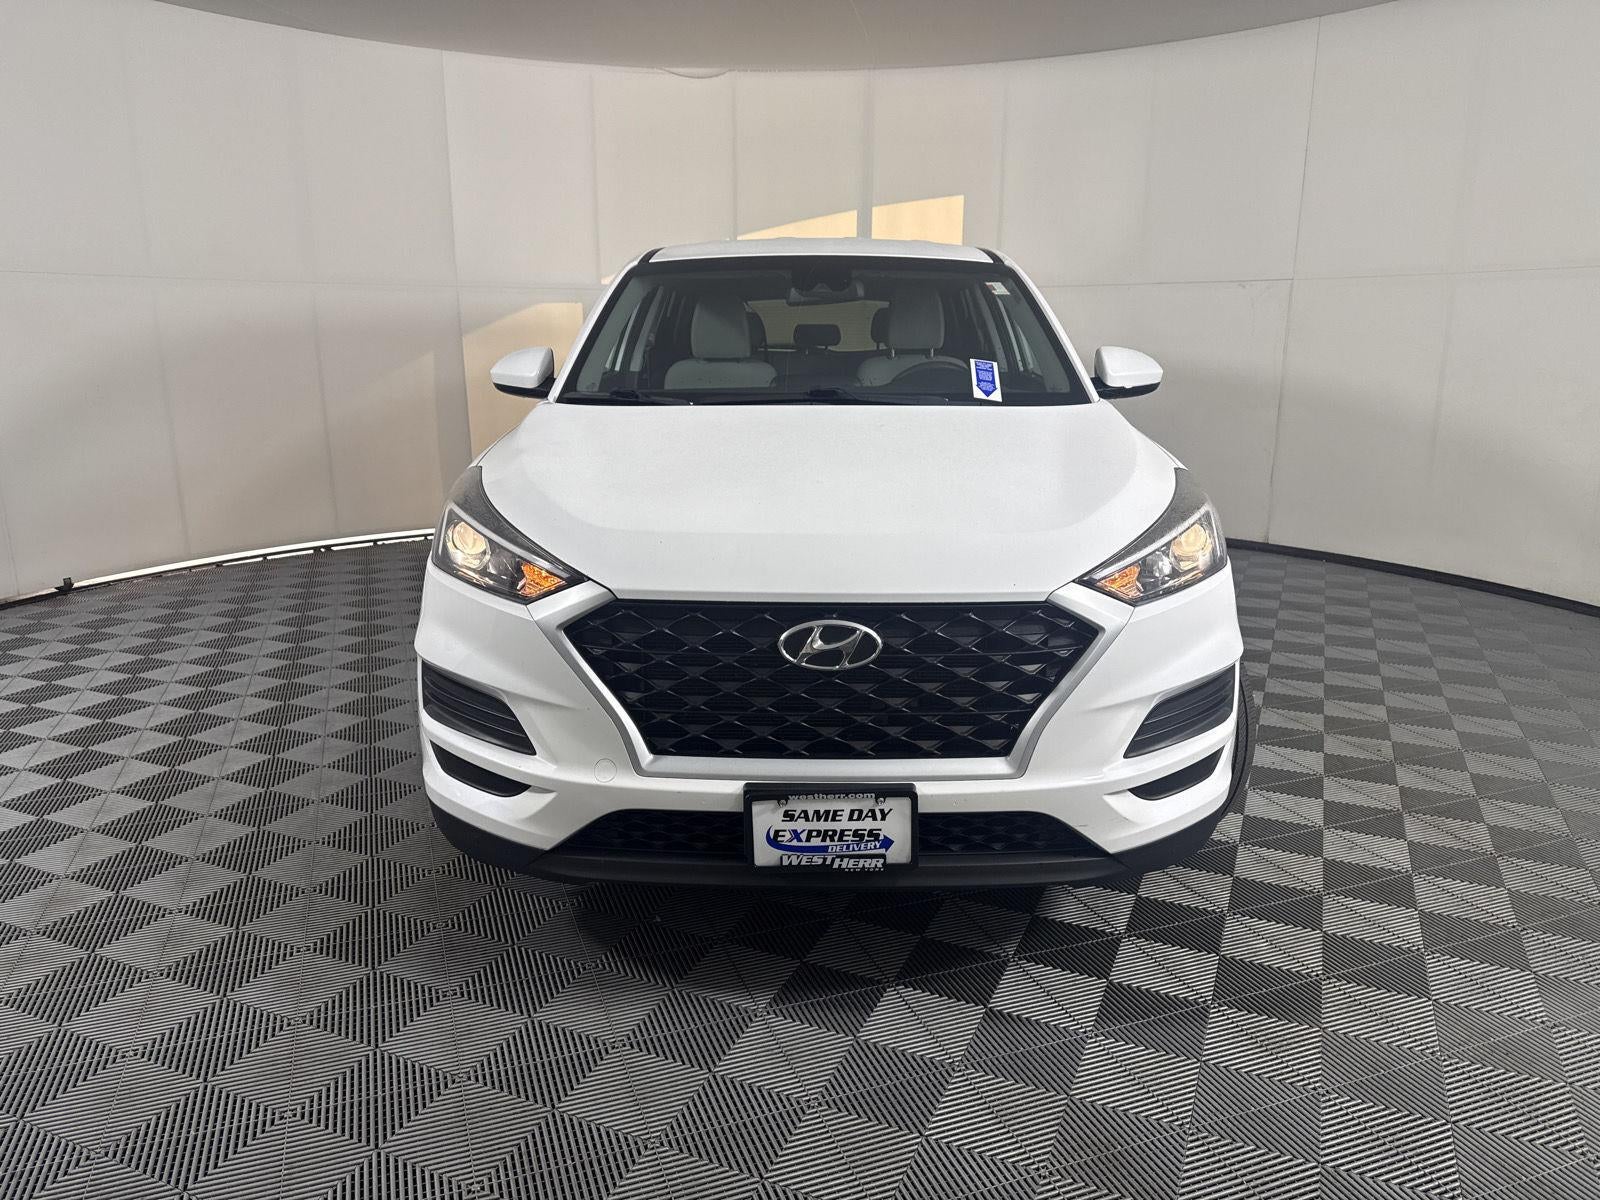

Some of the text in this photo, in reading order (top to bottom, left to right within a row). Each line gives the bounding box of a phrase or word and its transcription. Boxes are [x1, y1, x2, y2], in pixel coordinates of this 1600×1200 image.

[782, 808, 892, 822] SAME DAY
[773, 828, 882, 843] EXPRESS
[827, 841, 882, 853] DELIVERY
